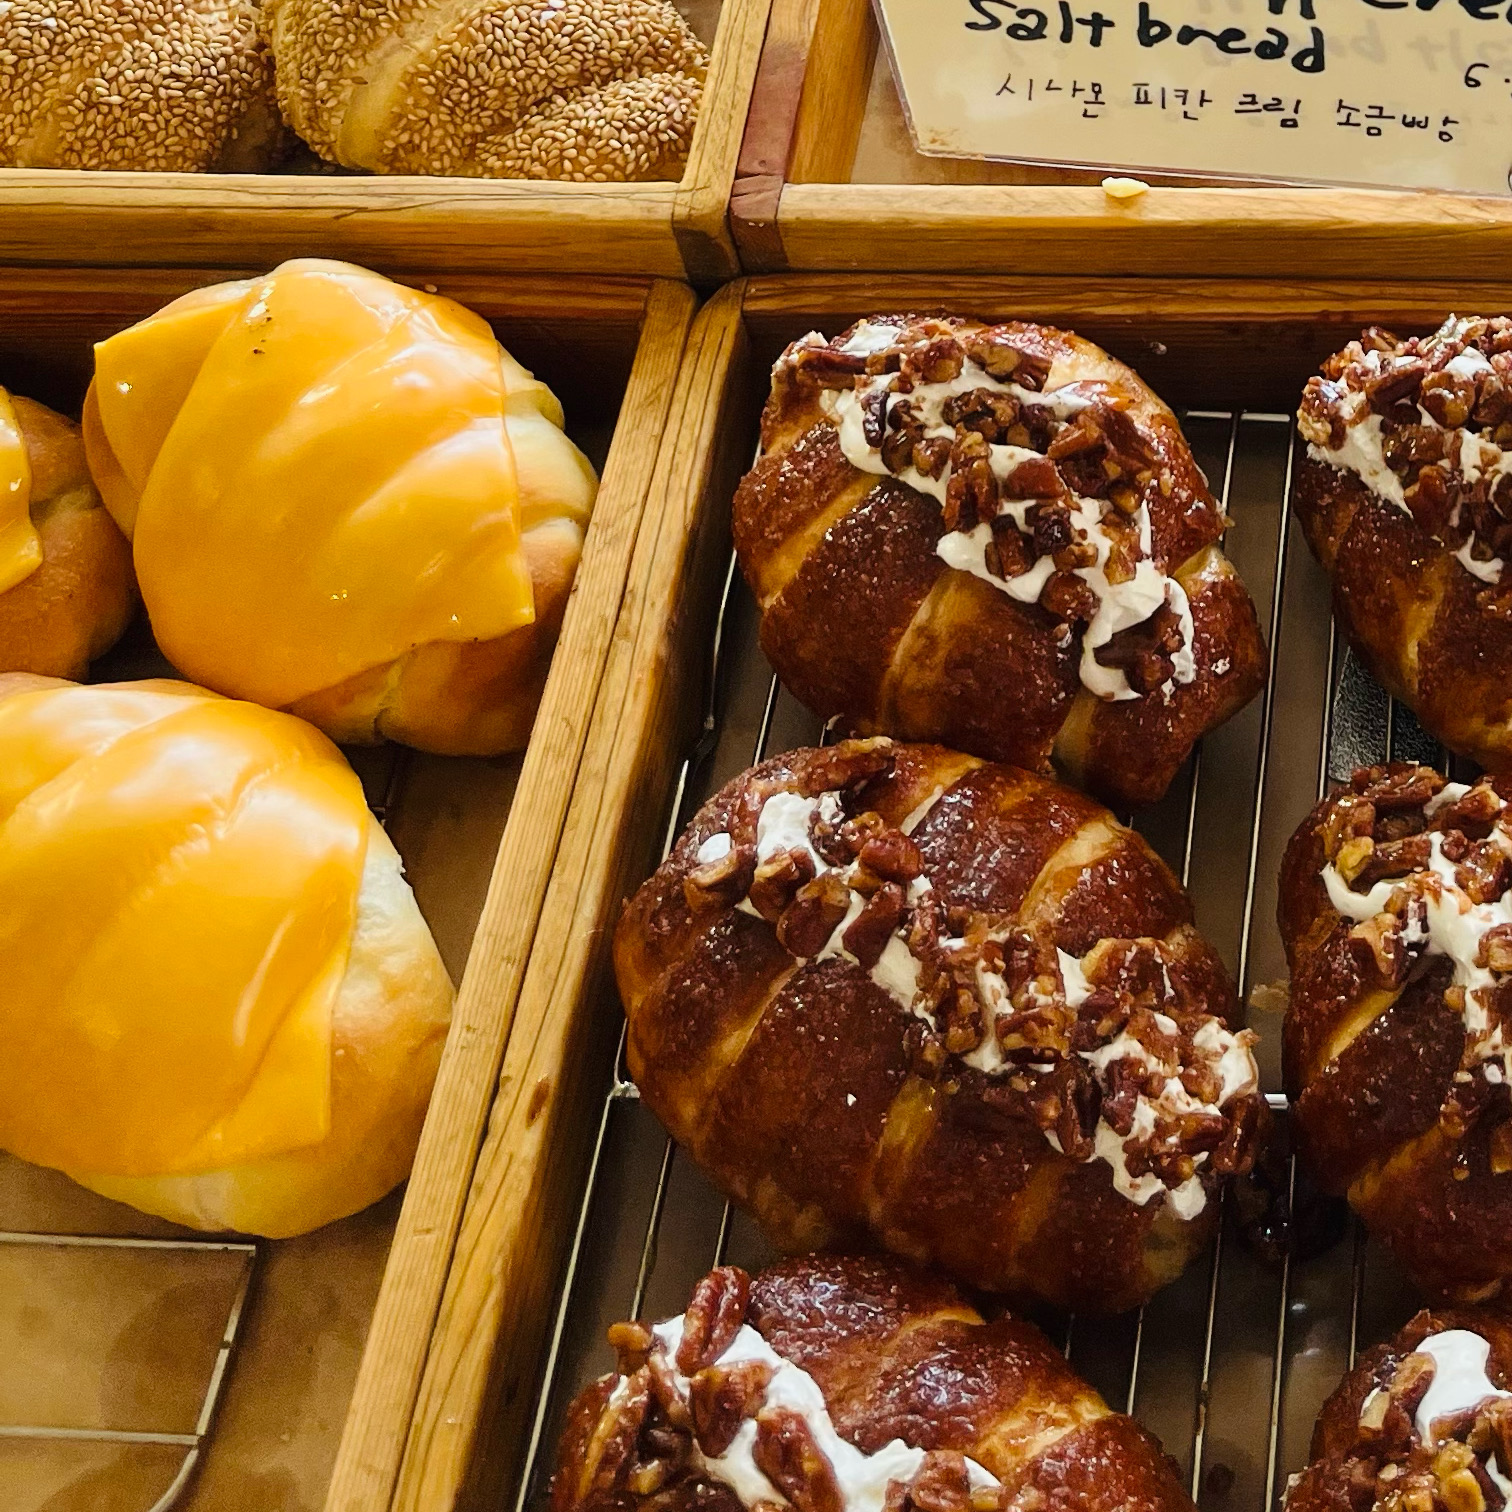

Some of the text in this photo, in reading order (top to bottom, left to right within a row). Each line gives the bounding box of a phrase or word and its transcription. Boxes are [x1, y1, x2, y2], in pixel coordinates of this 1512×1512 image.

[1136, 1, 1327, 74] bread
[996, 74, 1460, 143] 시나몬 피칸 크림 소금빵
